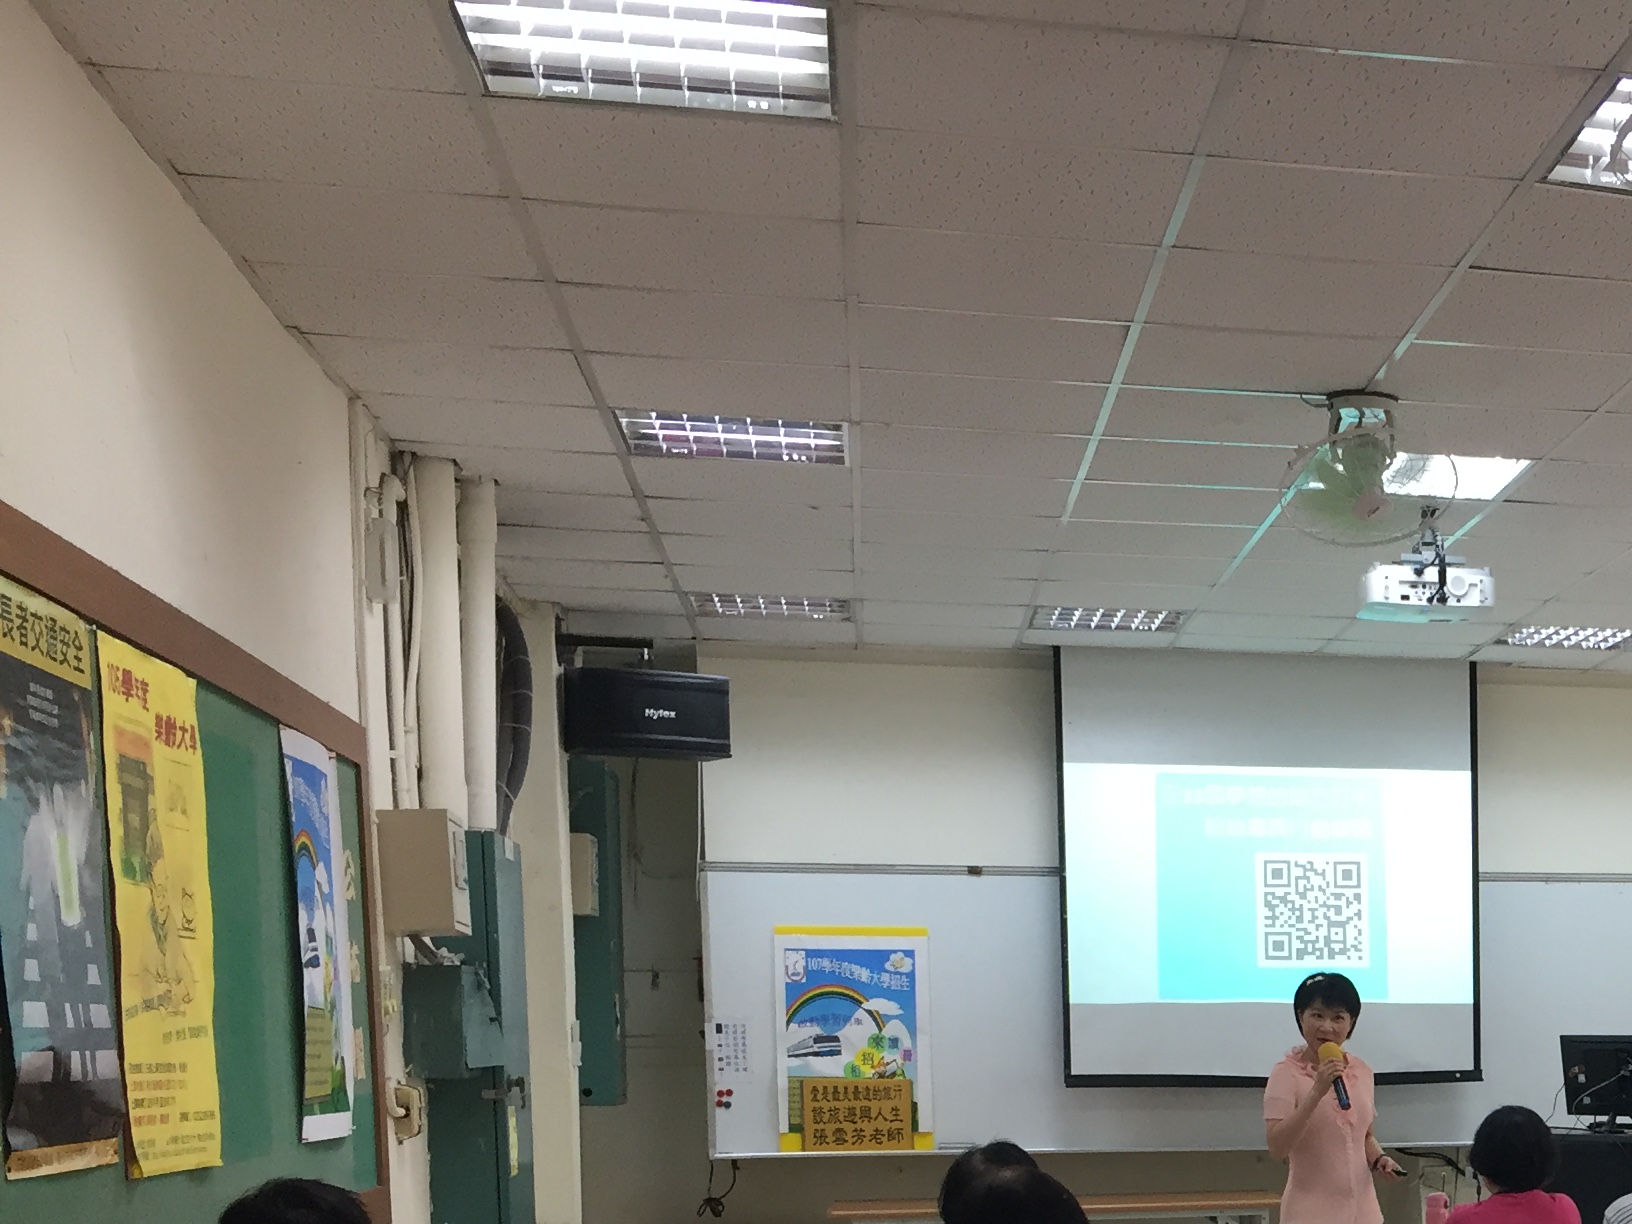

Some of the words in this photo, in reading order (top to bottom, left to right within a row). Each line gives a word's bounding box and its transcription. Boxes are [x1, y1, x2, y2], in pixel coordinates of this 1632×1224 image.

[0, 593, 86, 674] 長者交通安全
